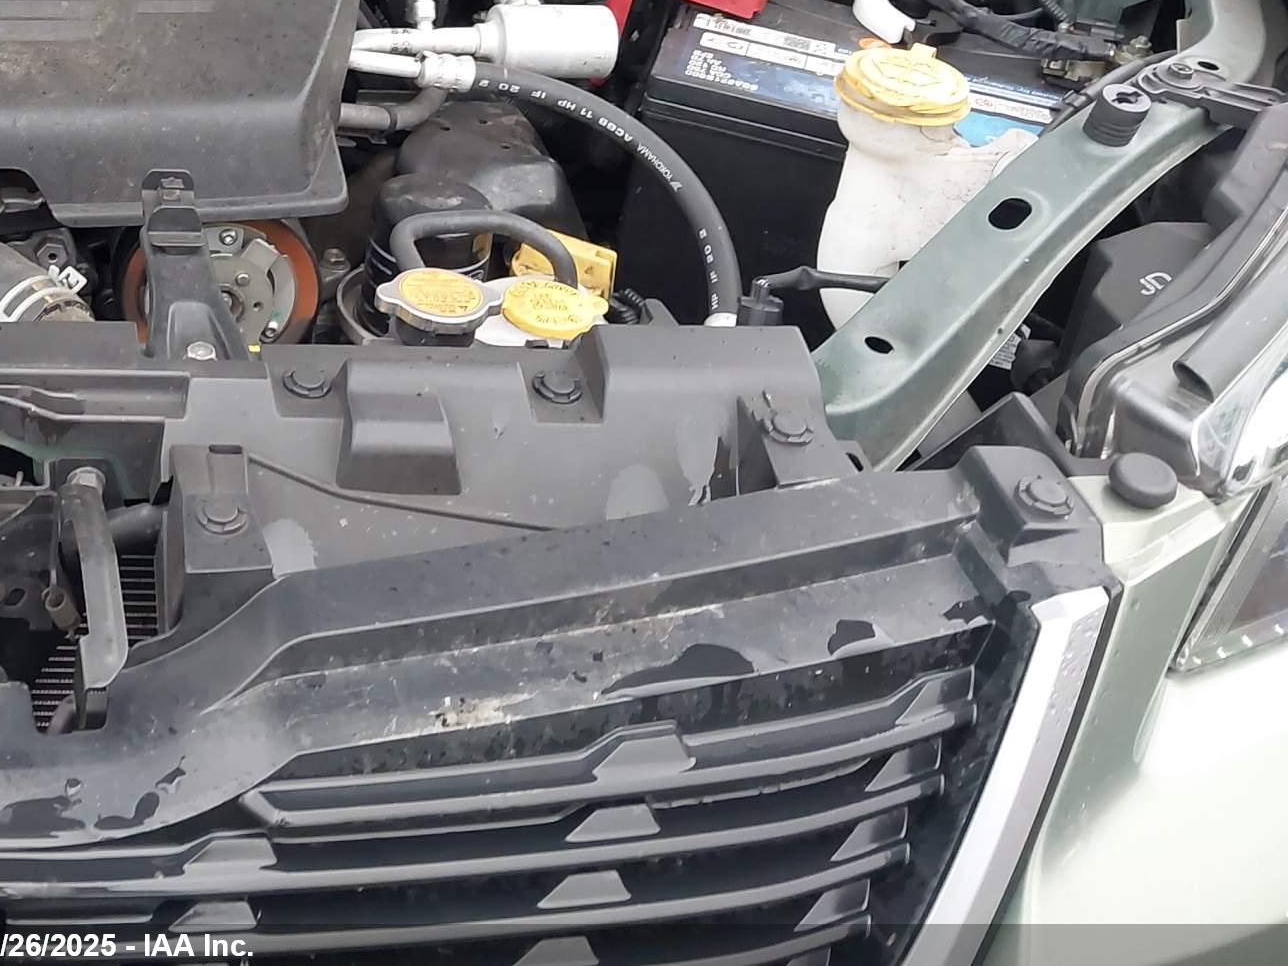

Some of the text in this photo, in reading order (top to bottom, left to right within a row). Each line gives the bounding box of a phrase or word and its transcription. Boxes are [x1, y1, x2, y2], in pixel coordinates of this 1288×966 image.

[478, 79, 490, 87] 2
[498, 82, 521, 93] 20
[557, 99, 576, 111] HP
[636, 142, 673, 182] YOKOHAMA
